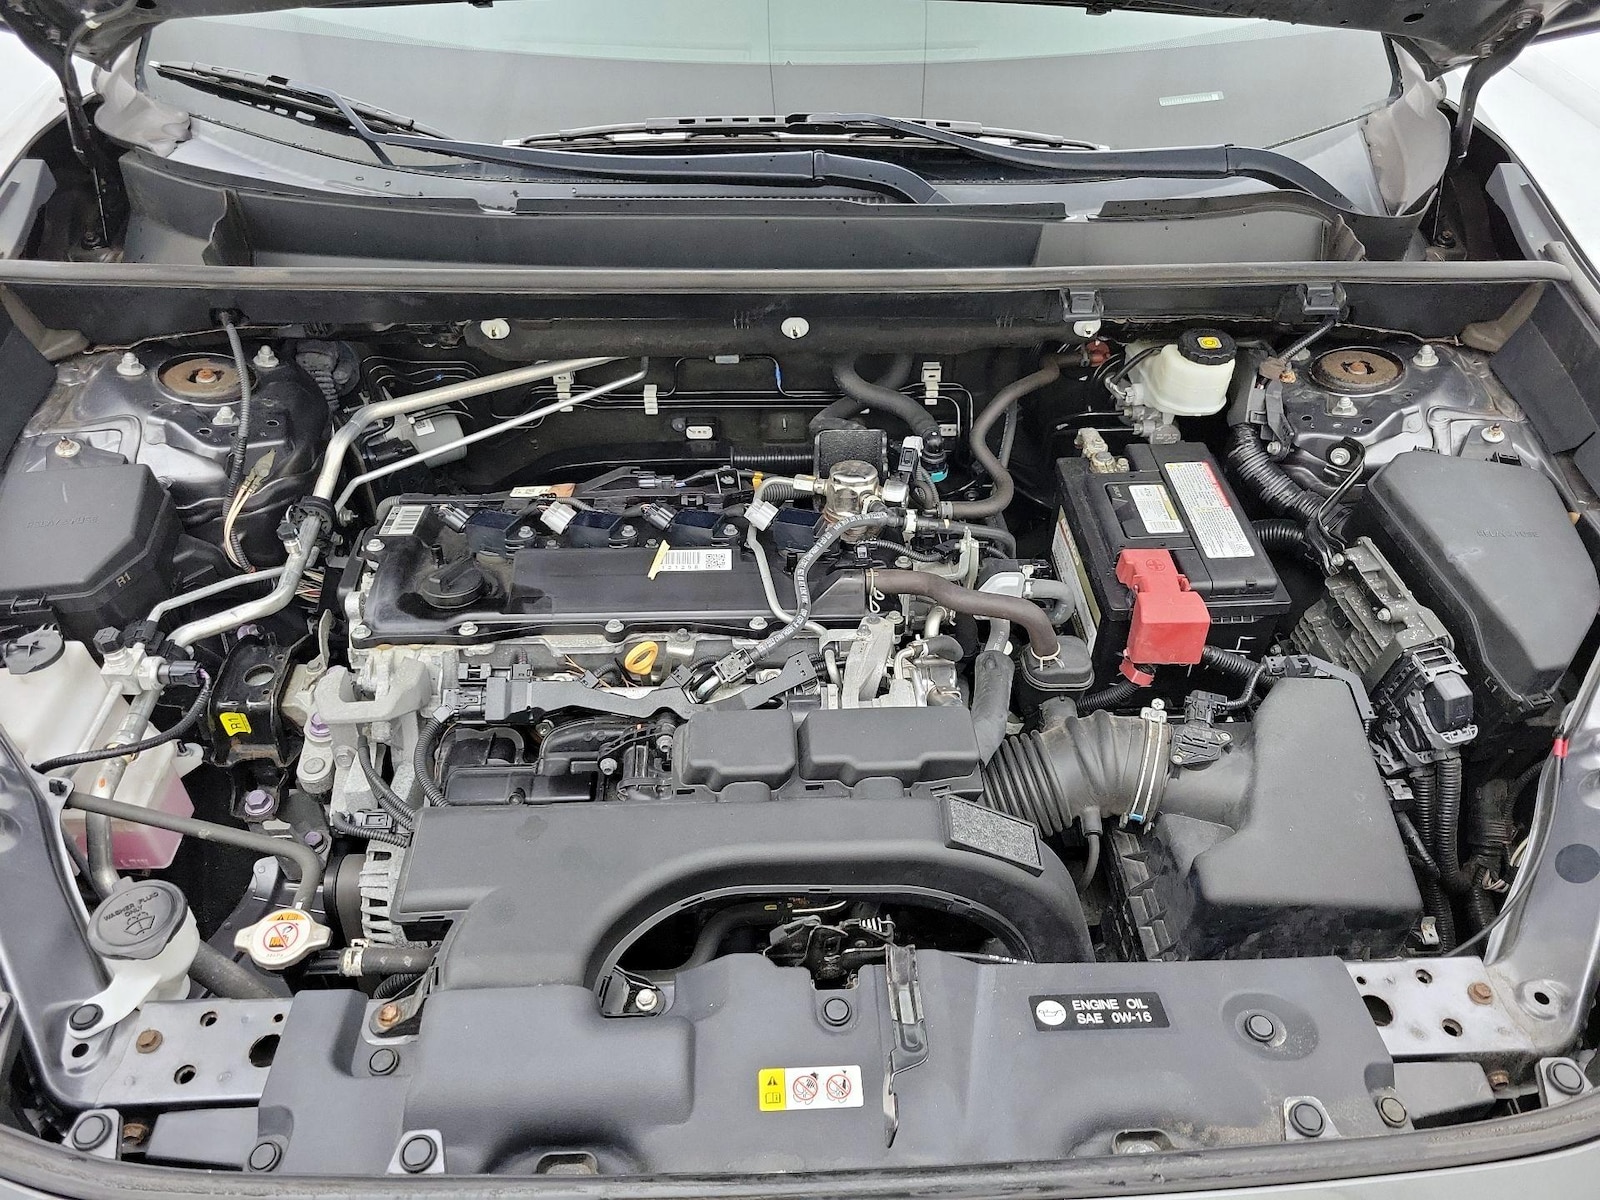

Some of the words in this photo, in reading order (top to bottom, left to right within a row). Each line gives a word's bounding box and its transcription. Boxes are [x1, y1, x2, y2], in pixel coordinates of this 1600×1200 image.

[103, 903, 135, 922] WASHER
[138, 892, 159, 905] FLUID
[124, 905, 143, 918] ONLY
[1071, 998, 1120, 1011] ENGINE
[1126, 997, 1149, 1009] OIL
[1076, 1012, 1105, 1025] SAE
[1111, 1011, 1153, 1024] 0W-16
